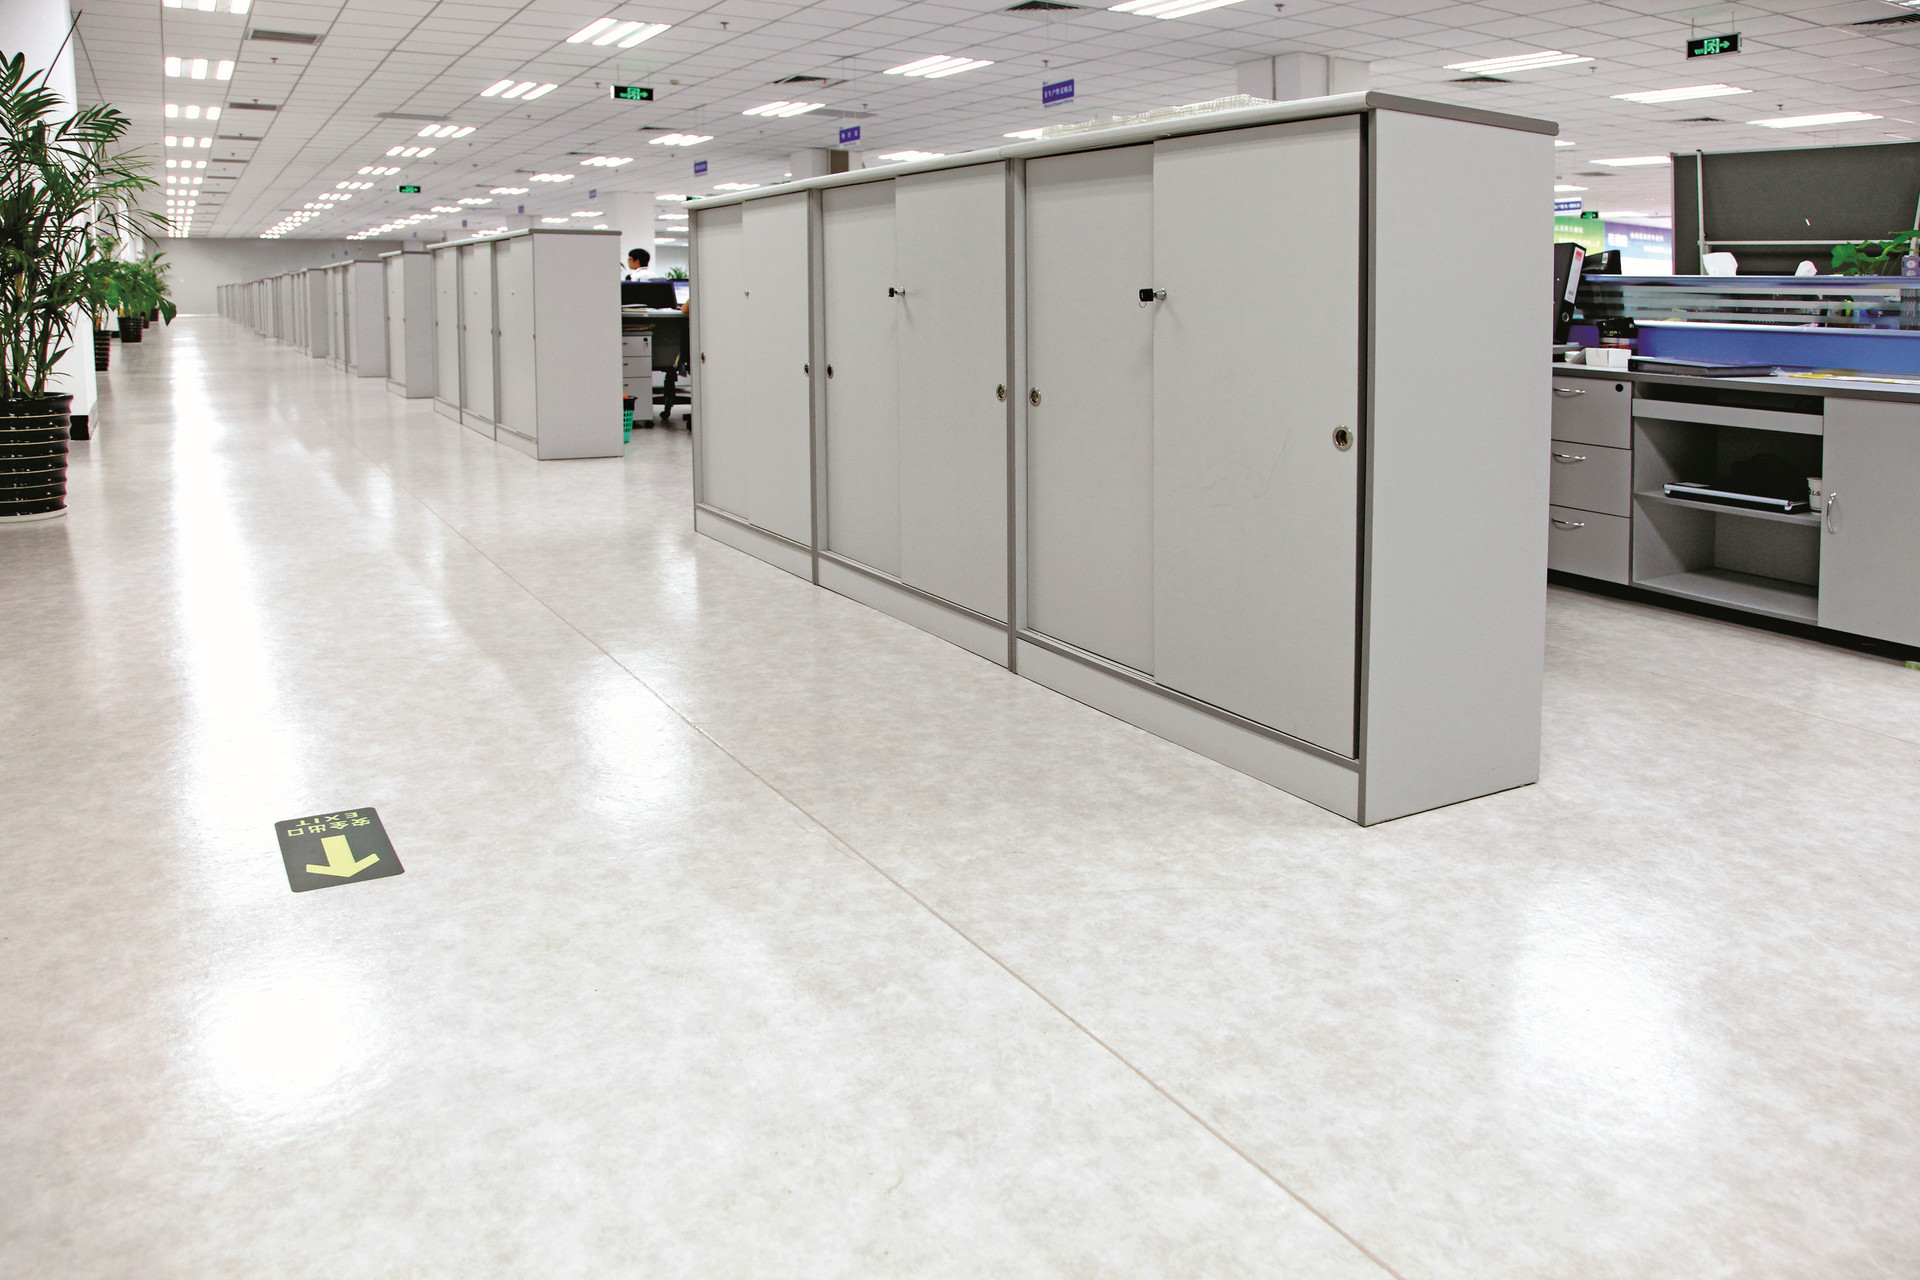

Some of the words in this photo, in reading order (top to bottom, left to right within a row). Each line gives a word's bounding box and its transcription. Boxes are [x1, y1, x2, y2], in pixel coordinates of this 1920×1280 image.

[287, 817, 370, 836] 安全出口
[296, 812, 358, 827] EXIT
